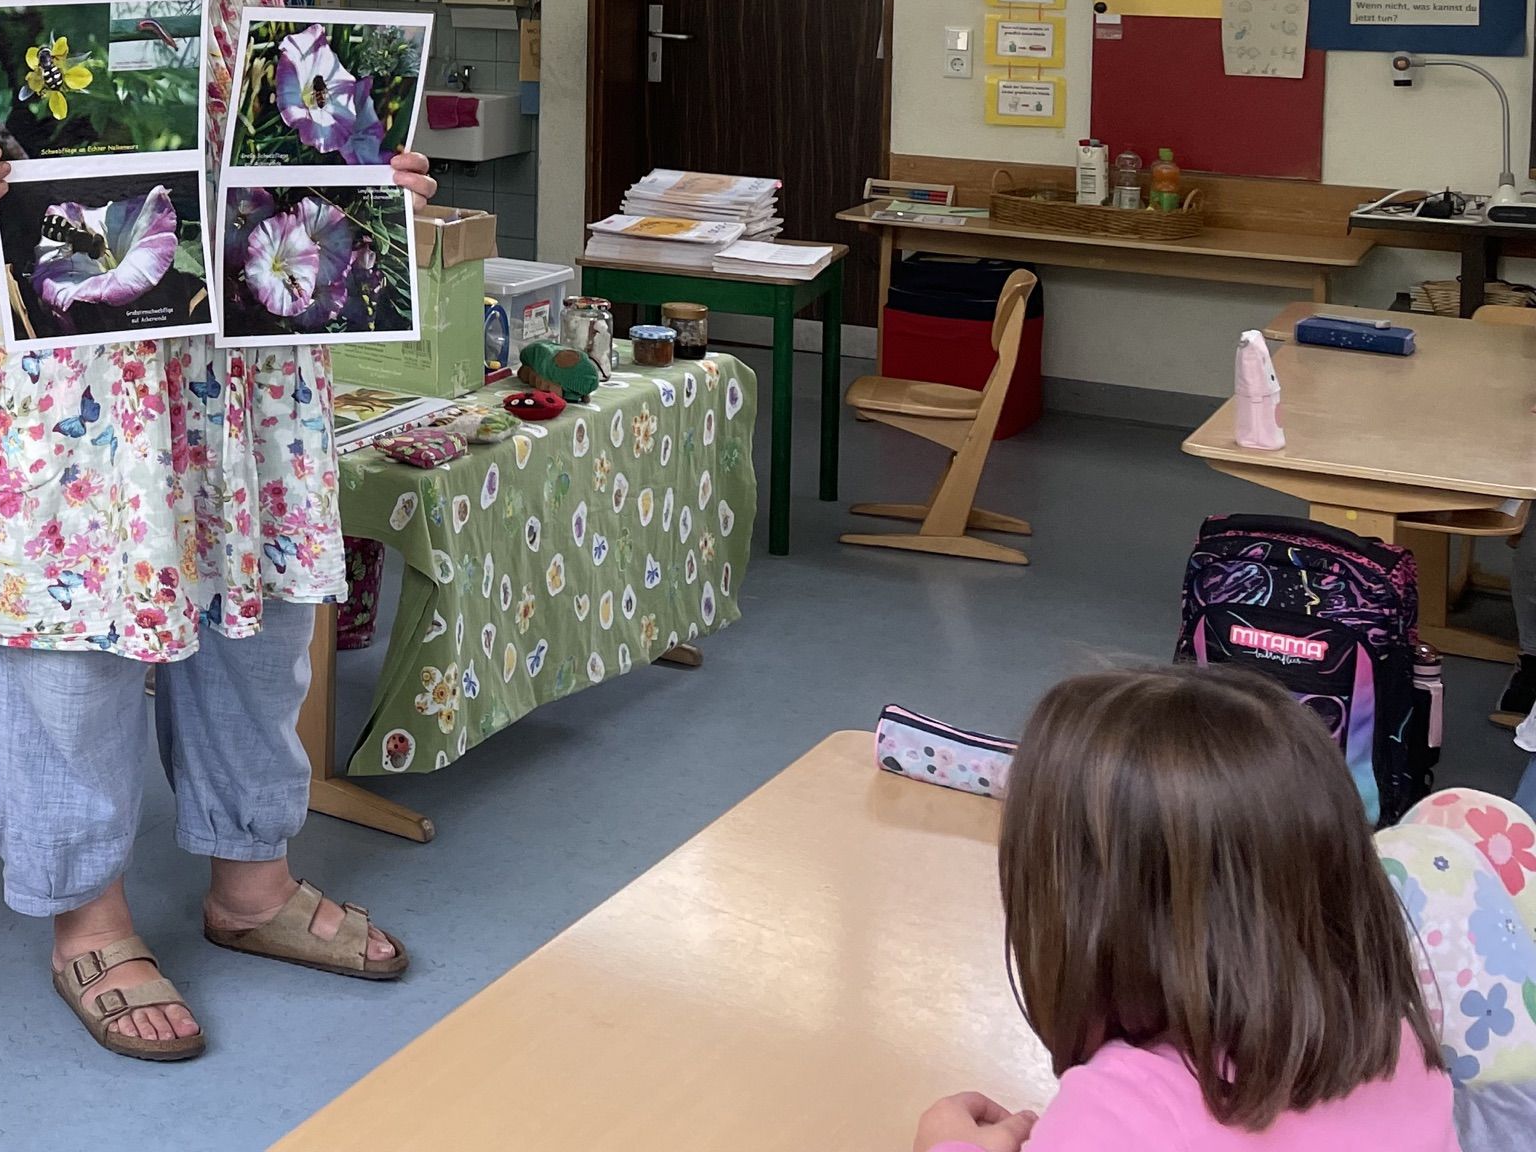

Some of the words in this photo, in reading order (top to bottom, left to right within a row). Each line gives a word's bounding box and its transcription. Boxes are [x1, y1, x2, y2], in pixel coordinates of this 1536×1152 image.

[1356, 2, 1382, 10] Wenn
[1413, 3, 1431, 11] was
[1433, 3, 1463, 11] kannst
[1465, 4, 1477, 12] du
[1355, 14, 1375, 23] jetzt
[1378, 14, 1398, 23] tun?
[1232, 627, 1323, 659] MITAMA
